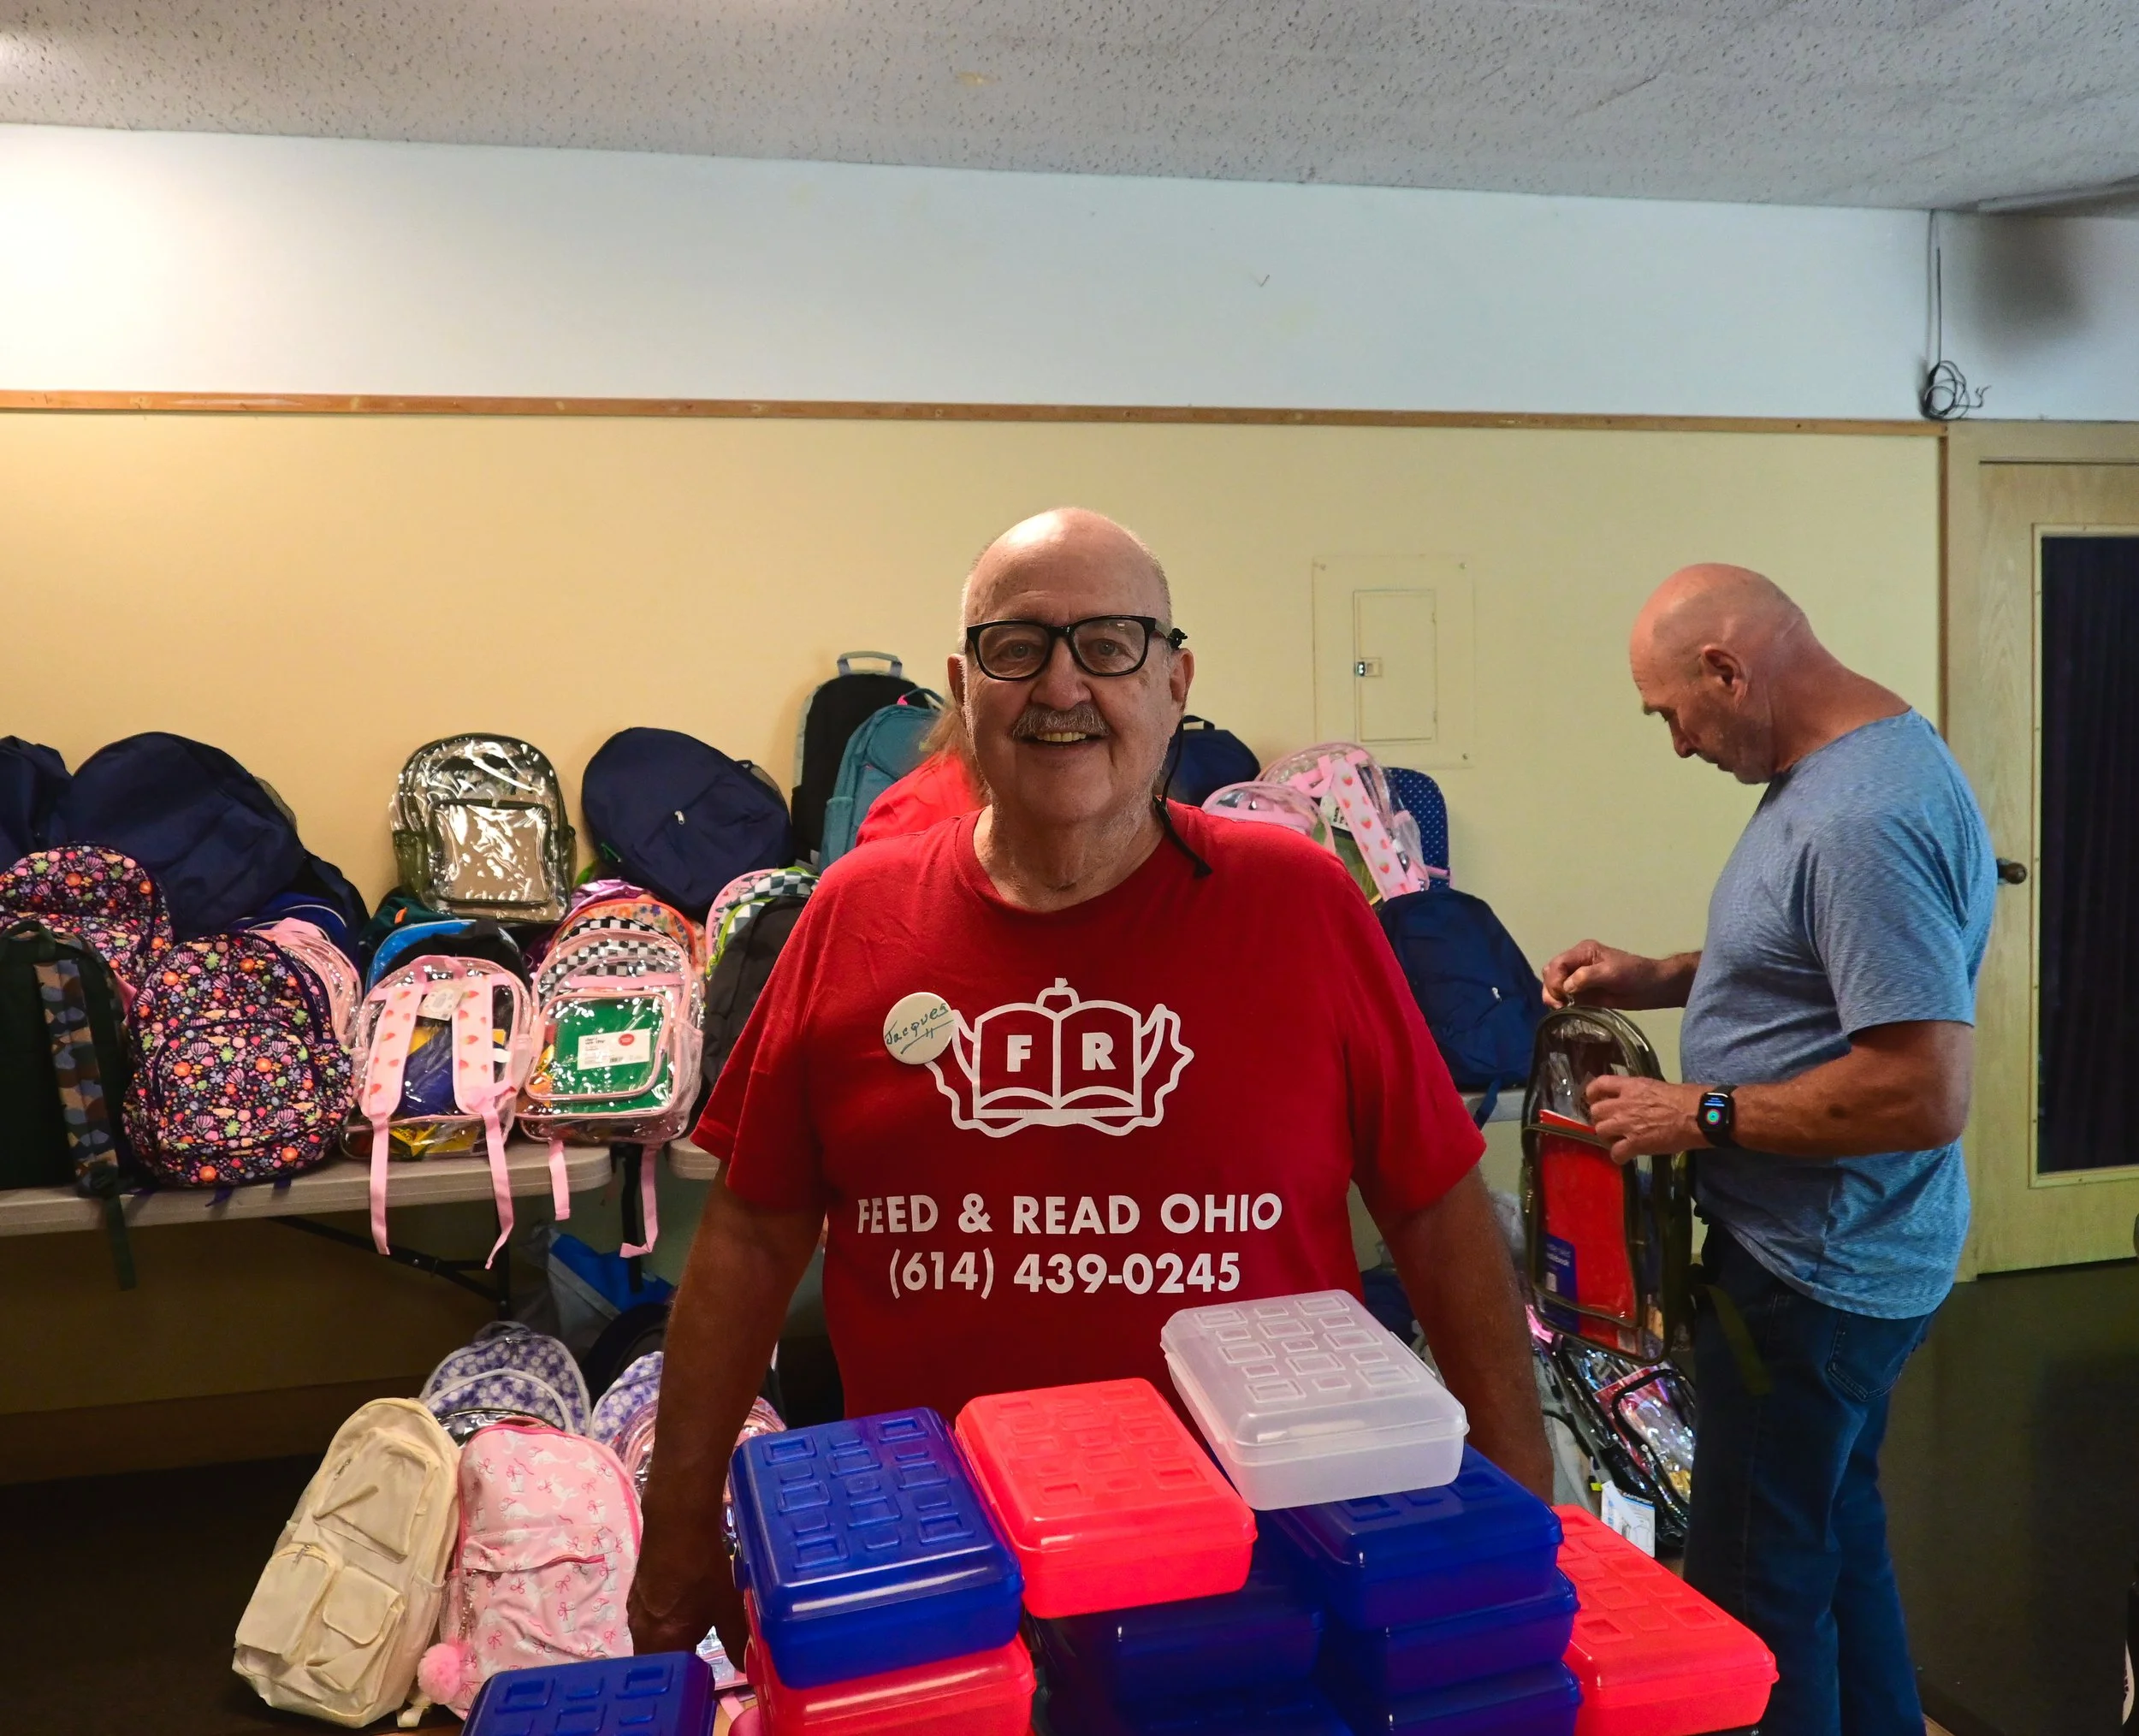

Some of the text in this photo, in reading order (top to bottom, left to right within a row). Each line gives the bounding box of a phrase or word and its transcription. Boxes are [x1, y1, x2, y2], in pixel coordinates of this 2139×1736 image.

[884, 1003, 949, 1045] Jacques
[1006, 1032, 1117, 1073] F R
[857, 1193, 1283, 1235] FEED & READ OHIO
[889, 1247, 1241, 1300] (614) 439-0245
